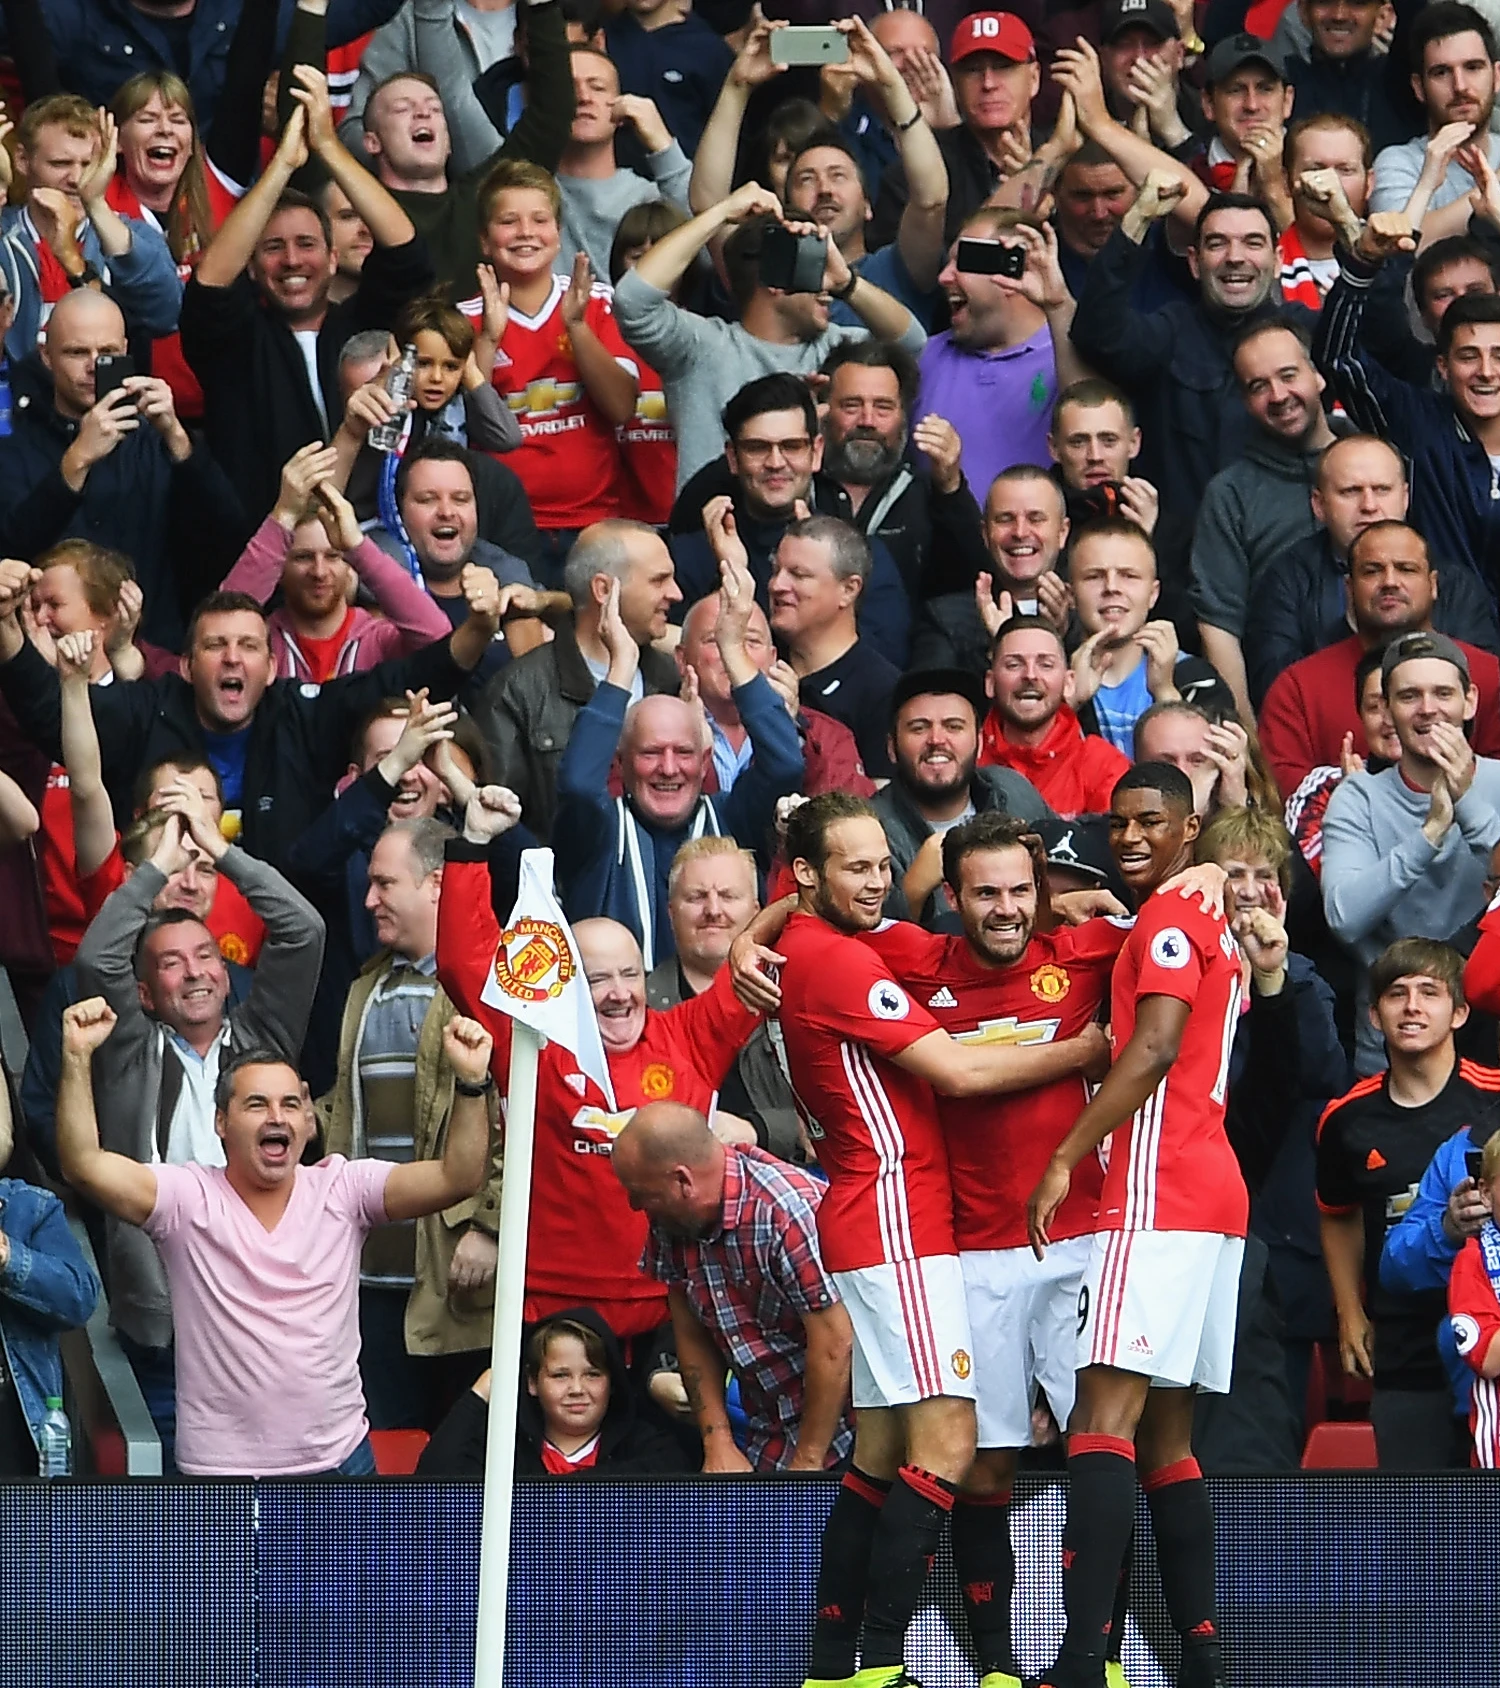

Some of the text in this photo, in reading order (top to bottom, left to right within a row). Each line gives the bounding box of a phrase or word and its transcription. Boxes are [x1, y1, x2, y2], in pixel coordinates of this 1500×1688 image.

[971, 17, 999, 37] 10
[519, 414, 586, 438] EVROLET
[497, 923, 570, 999] MANCHESTER UNITED
